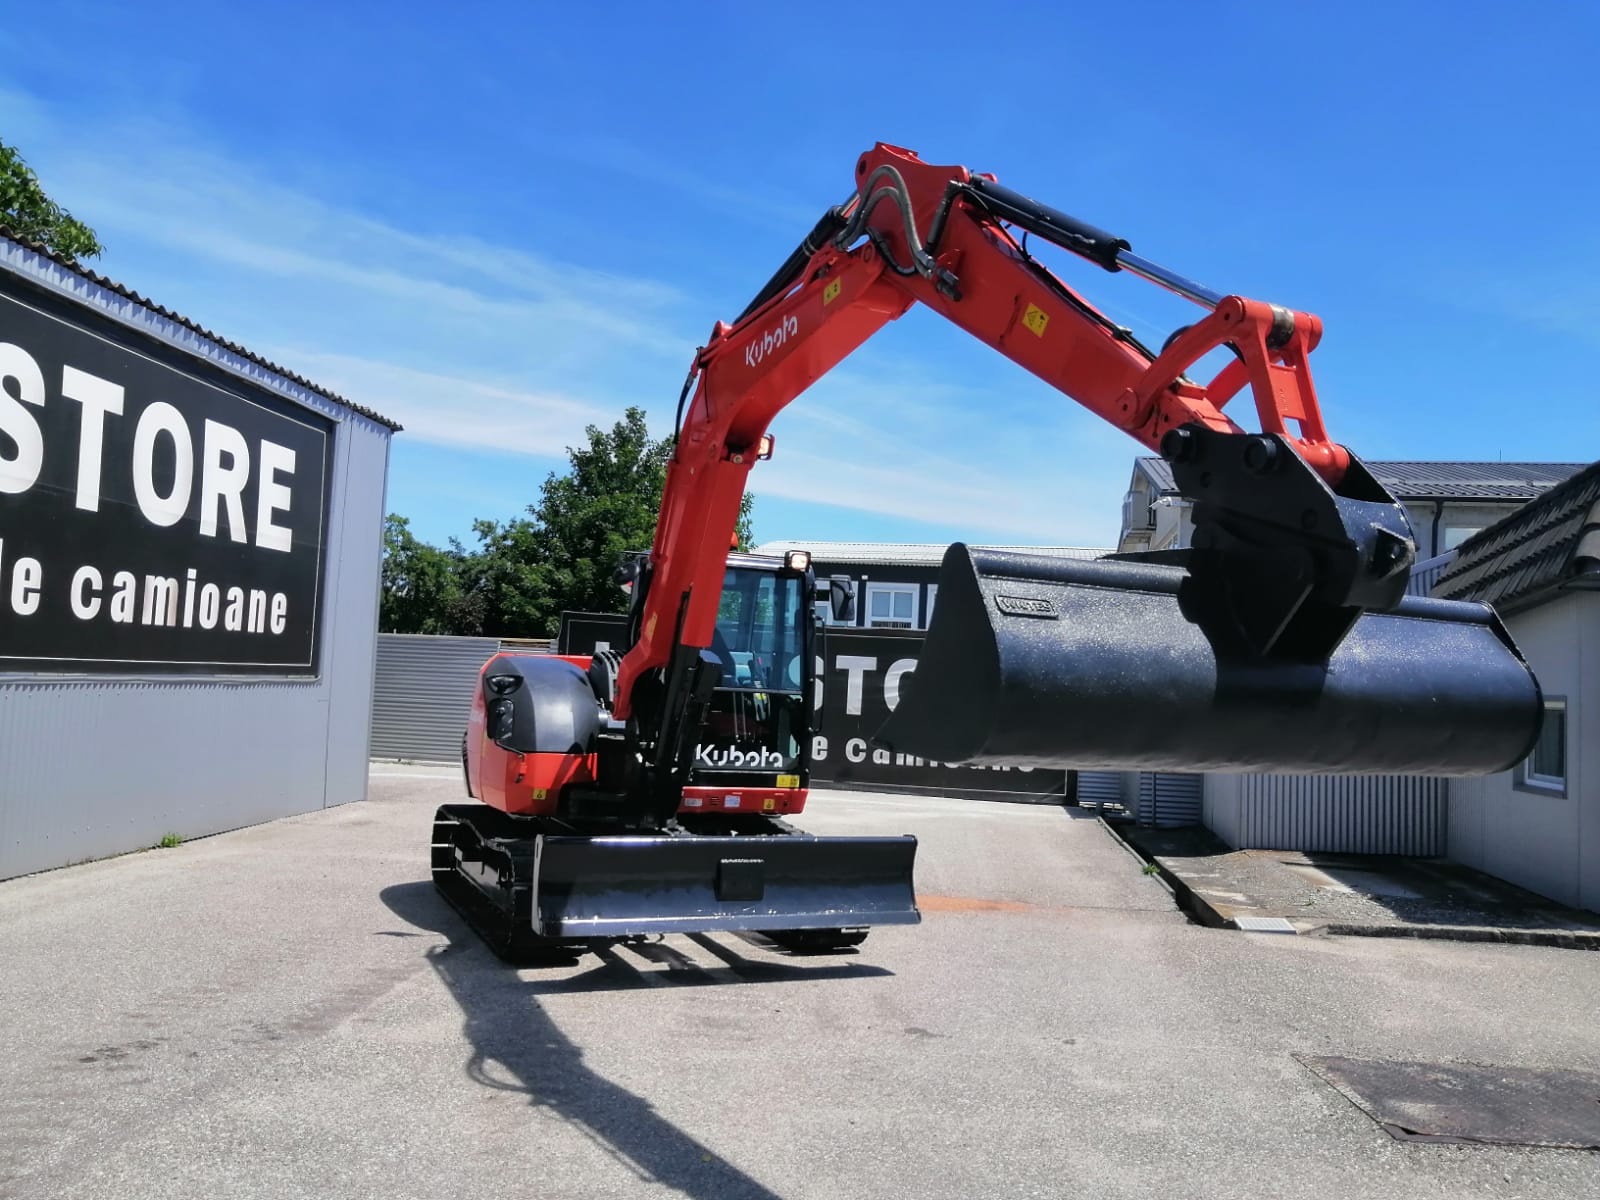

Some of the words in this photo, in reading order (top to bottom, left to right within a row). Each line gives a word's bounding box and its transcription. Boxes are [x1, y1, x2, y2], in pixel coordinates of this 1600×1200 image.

[746, 315, 798, 367] Kubota
[0, 342, 296, 552] STORE
[70, 565, 288, 635] camioane
[695, 743, 783, 768] Kubota
